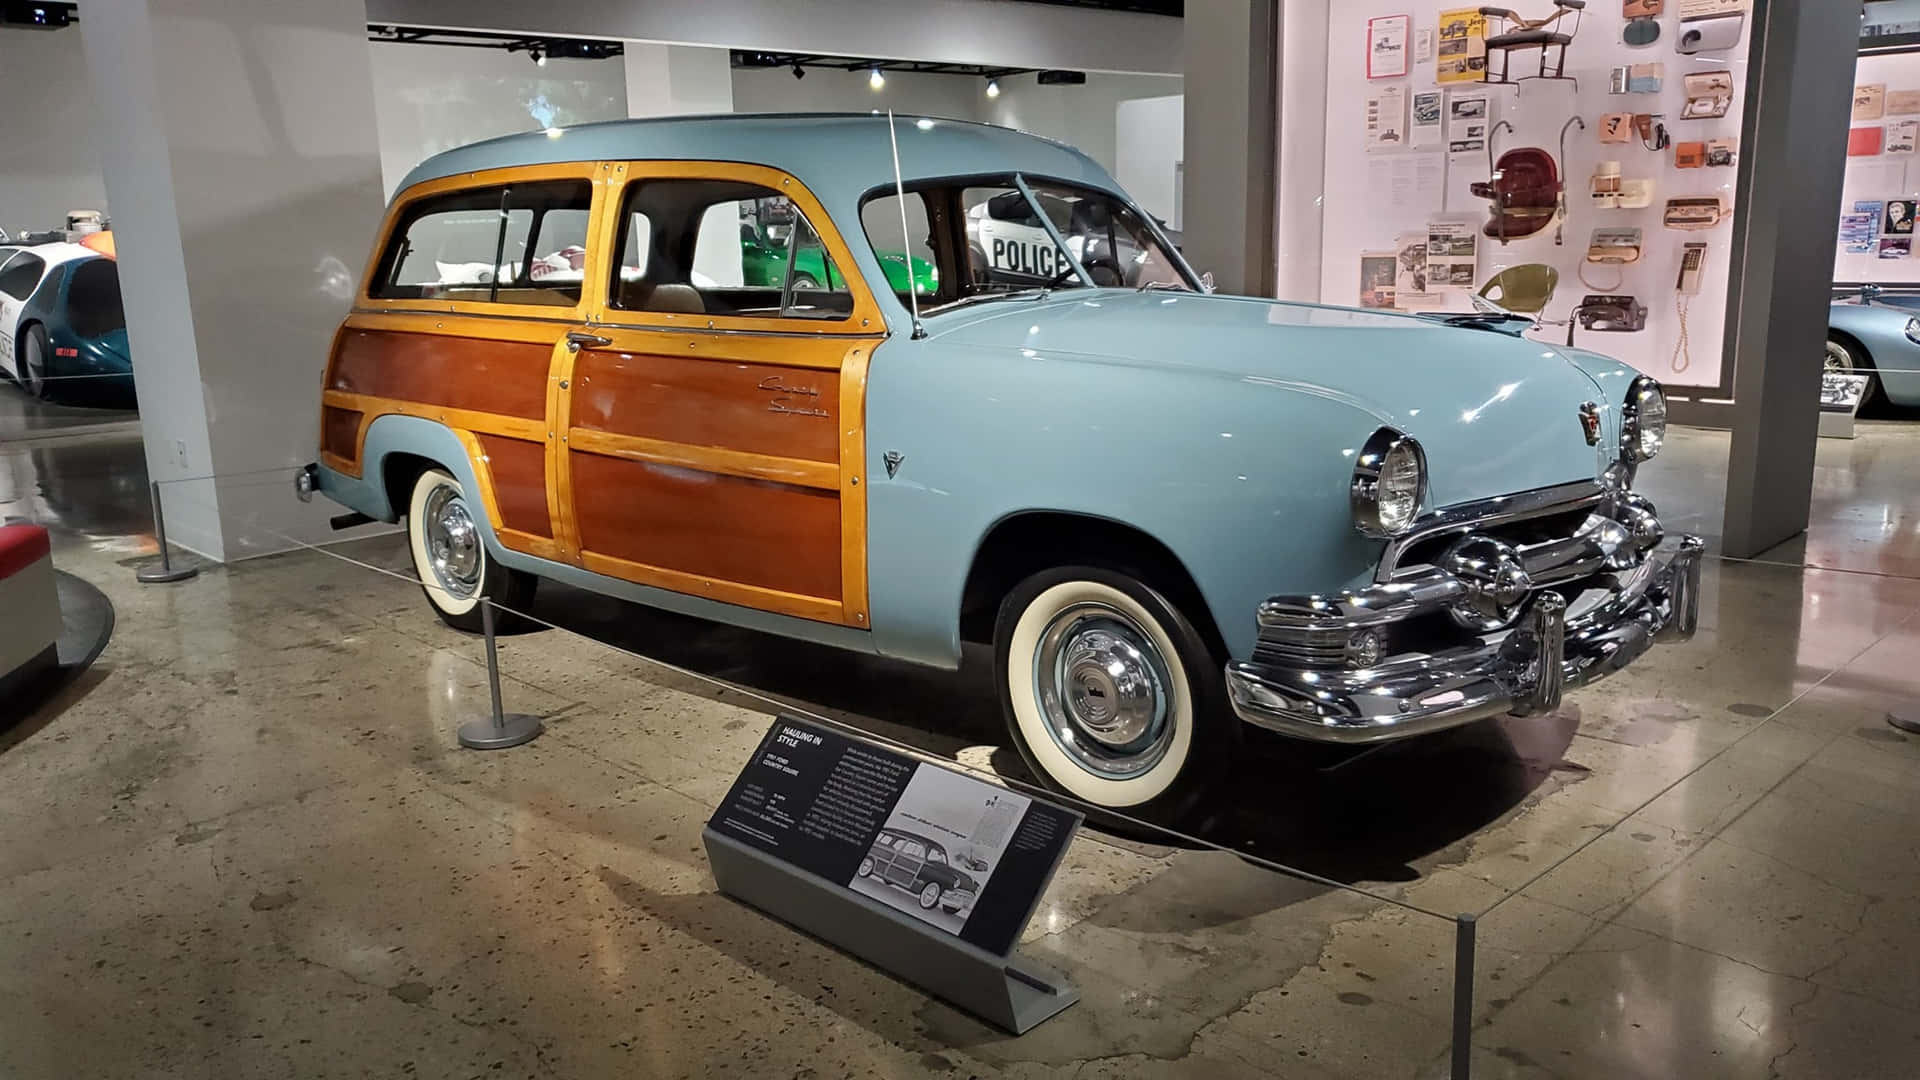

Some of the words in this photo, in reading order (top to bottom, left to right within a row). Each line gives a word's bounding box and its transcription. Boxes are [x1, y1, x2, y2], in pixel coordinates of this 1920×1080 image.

[776, 734, 800, 748] STYLE
[782, 726, 814, 743] HAULING
[812, 735, 823, 746] IN
